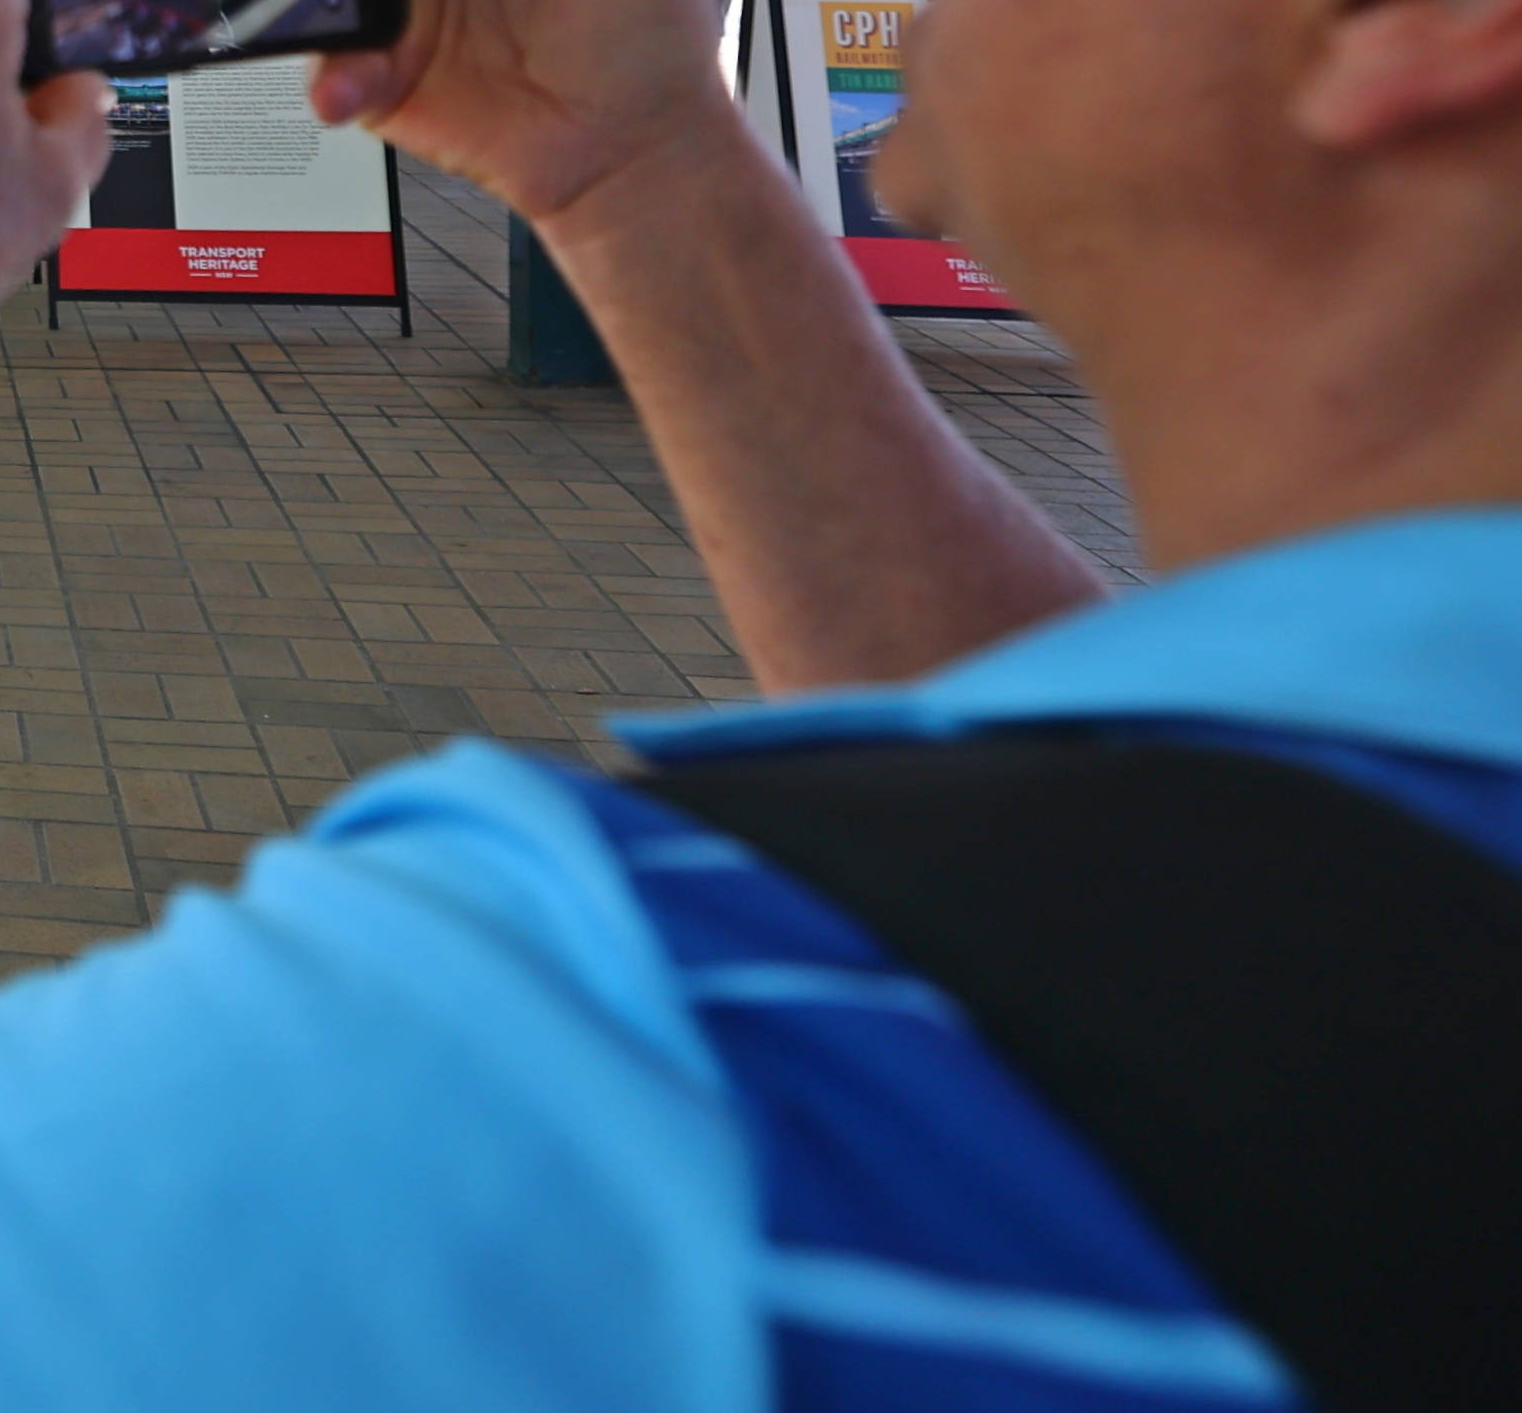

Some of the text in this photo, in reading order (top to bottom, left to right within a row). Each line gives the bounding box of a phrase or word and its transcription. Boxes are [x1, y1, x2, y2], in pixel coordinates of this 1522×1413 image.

[833, 9, 901, 48] CPH
[178, 246, 265, 258] TRANSPORT
[188, 259, 258, 271] HERITAGE
